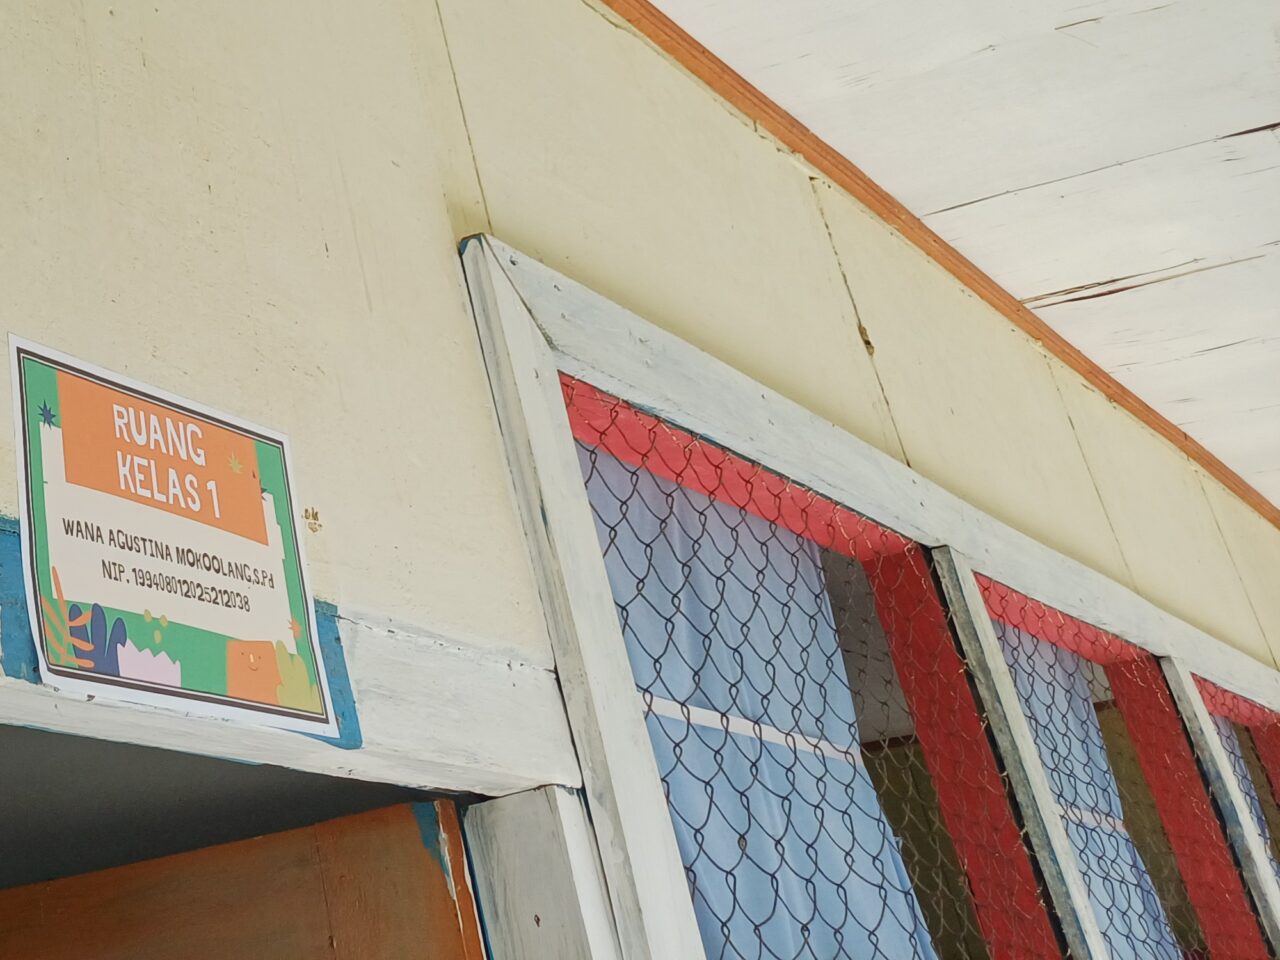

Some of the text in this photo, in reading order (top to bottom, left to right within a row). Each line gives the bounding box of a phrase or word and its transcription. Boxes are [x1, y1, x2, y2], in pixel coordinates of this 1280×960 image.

[112, 403, 207, 467] RUANG
[116, 450, 221, 520] KELAS 1
[62, 517, 104, 544] WANA
[108, 529, 173, 563] AGUSTINA
[101, 559, 251, 613] NIP. 199408012025212038
